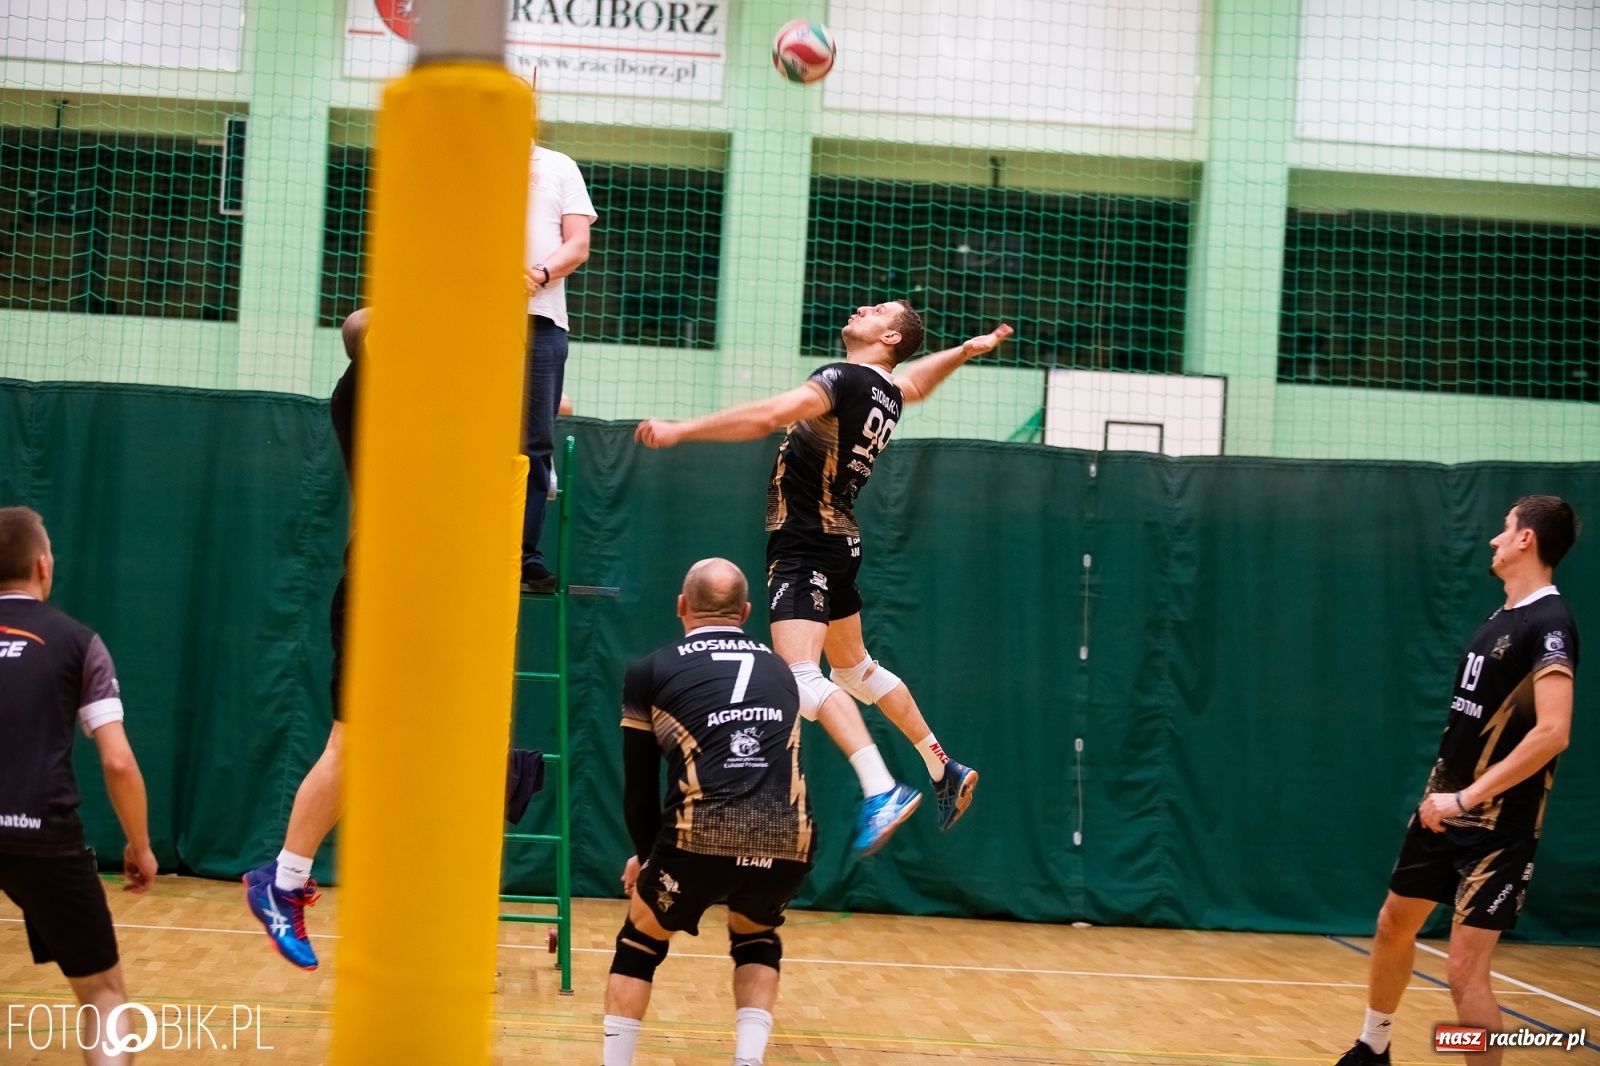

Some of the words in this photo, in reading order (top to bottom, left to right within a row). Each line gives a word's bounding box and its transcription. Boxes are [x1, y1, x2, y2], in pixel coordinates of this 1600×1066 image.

[677, 639, 773, 656] KOSMALA
[711, 652, 755, 704] 7
[1460, 652, 1485, 692] 19
[707, 707, 783, 727] AGROTIM
[736, 856, 773, 869] TEAM
